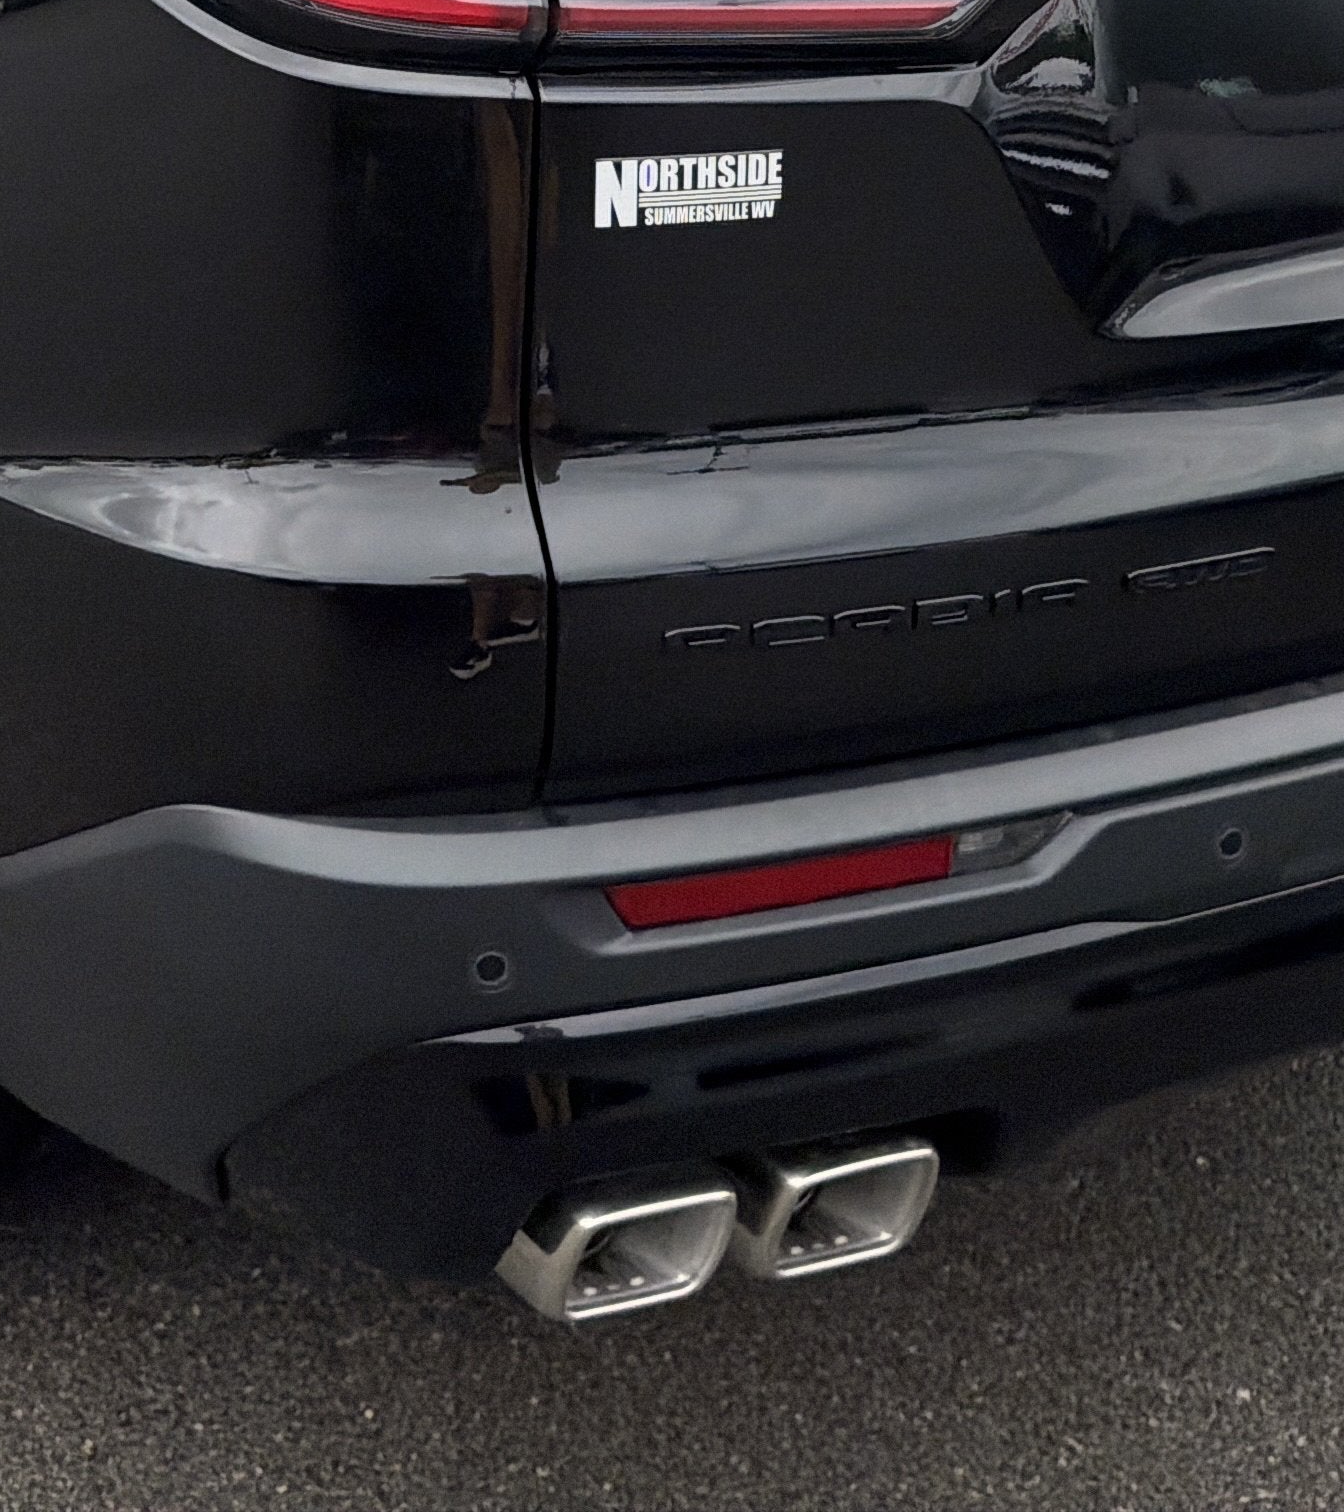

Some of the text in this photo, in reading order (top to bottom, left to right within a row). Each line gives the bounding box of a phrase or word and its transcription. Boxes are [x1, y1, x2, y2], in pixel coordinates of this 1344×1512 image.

[594, 152, 783, 228] NORTHSIDE
[644, 200, 776, 226] SUMMERSVILLE WV
